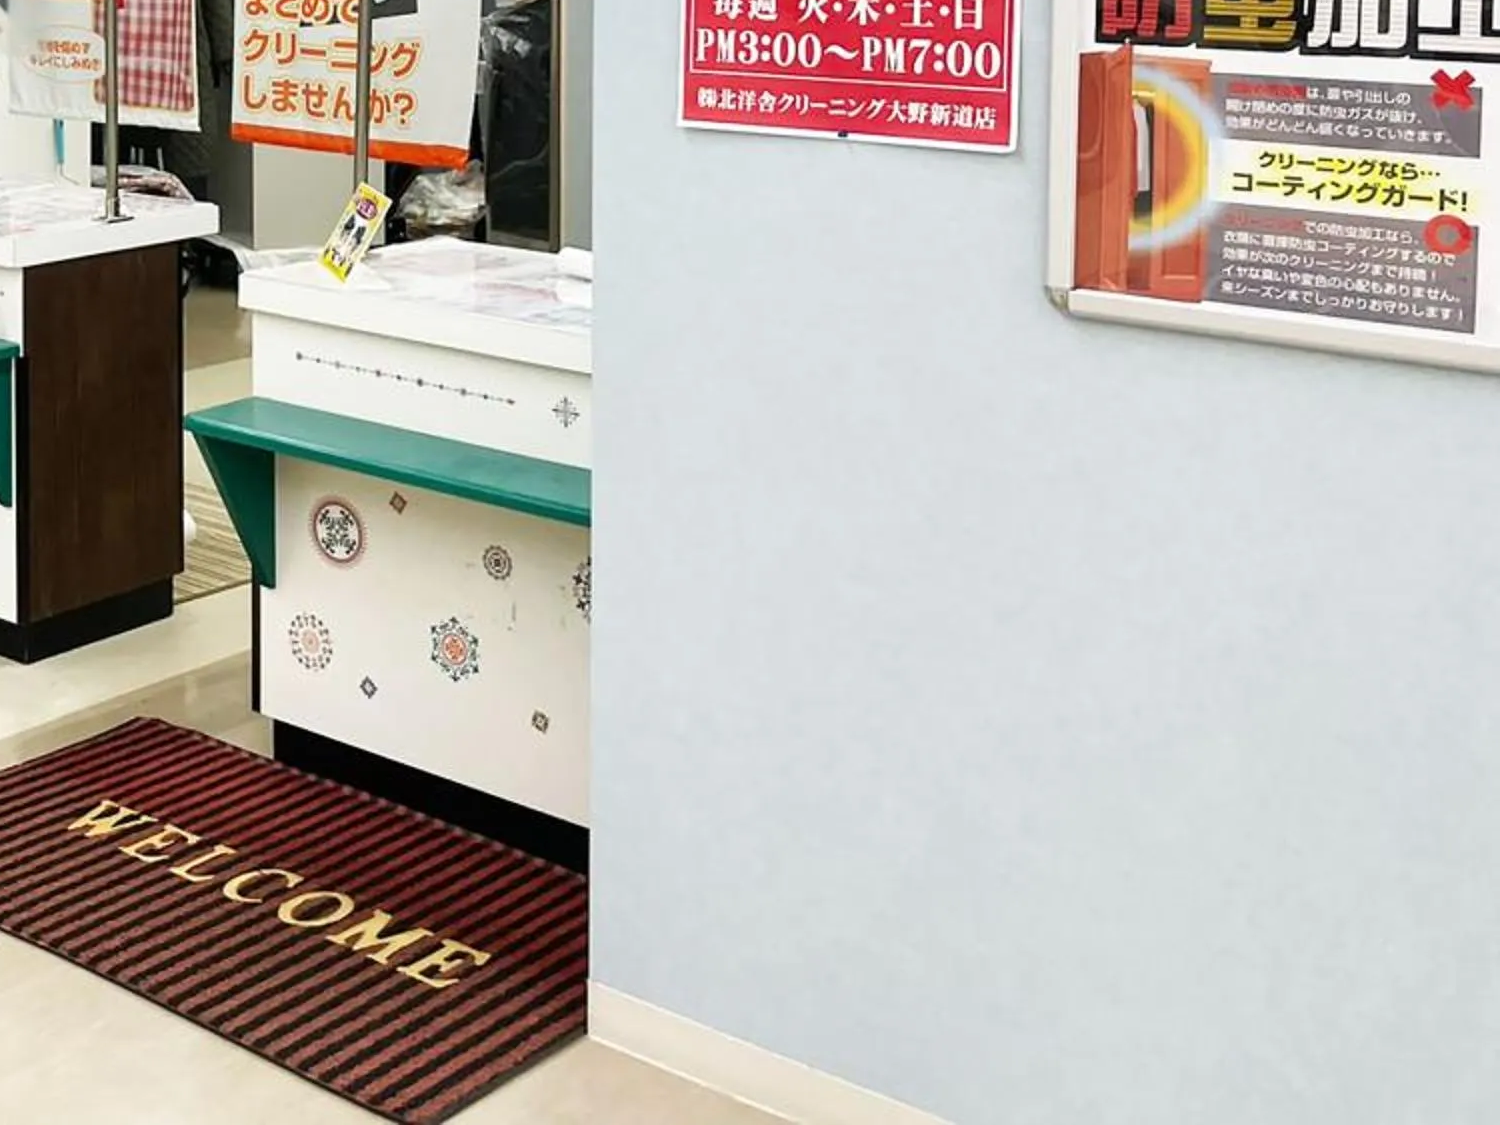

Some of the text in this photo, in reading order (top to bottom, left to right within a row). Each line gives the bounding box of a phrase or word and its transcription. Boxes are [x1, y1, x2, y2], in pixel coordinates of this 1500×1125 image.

[243, 28, 421, 78] クリーニング
[243, 75, 417, 125] しませんか?
[1232, 171, 1470, 213] コーティングガード!
[66, 797, 494, 992] WELCOME
